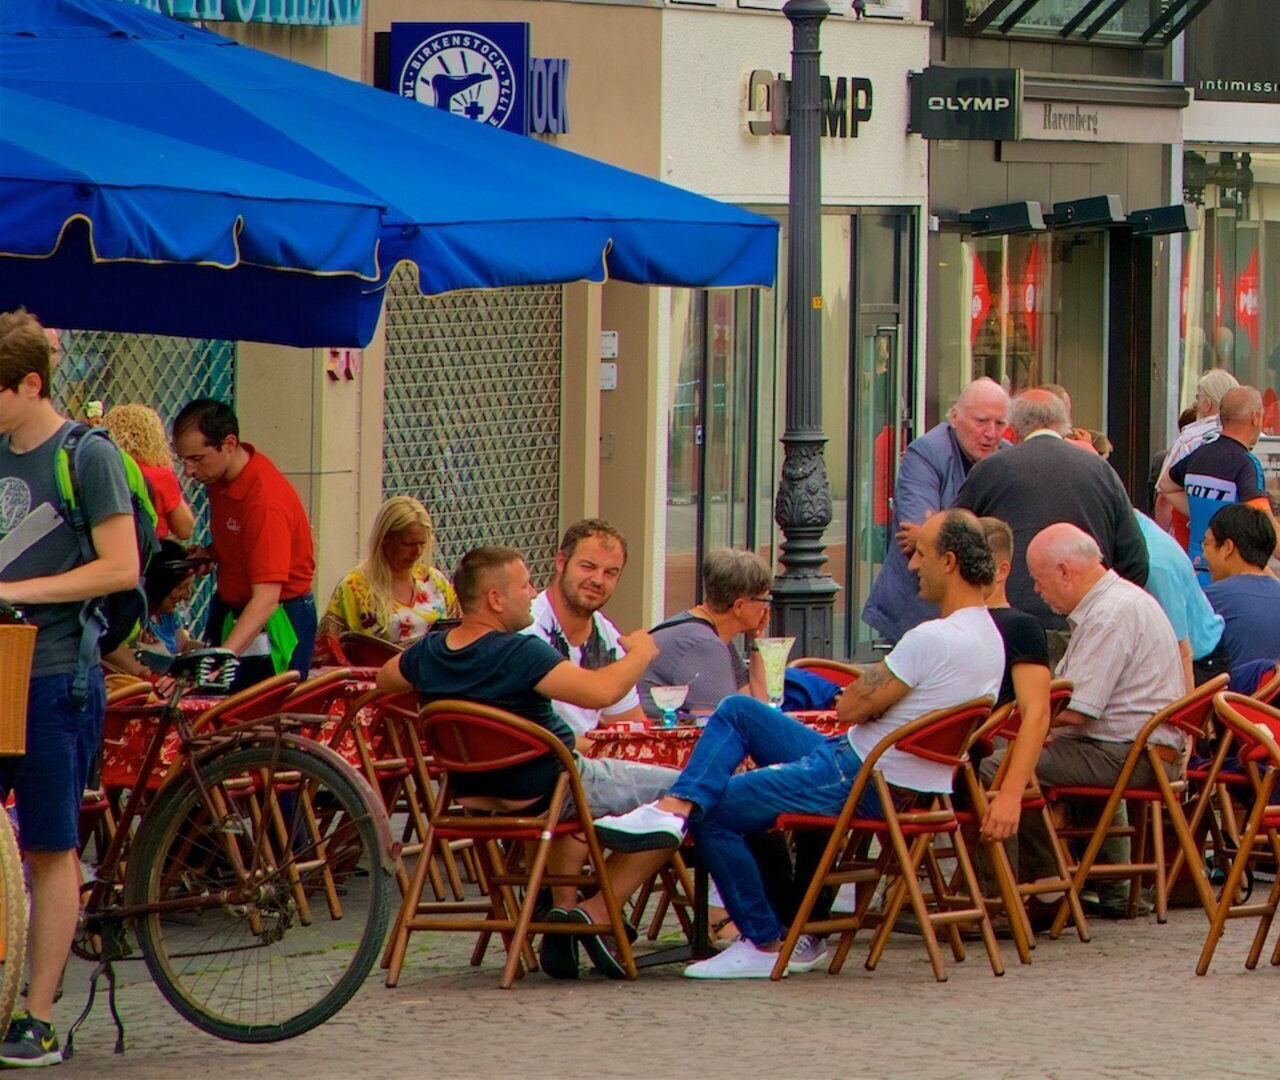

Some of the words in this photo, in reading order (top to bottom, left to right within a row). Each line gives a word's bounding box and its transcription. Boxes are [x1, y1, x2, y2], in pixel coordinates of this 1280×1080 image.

[411, 35, 506, 71] BIRKENSTOCK
[928, 96, 1010, 111] OLYMP
[1042, 102, 1099, 135] Harenberg
